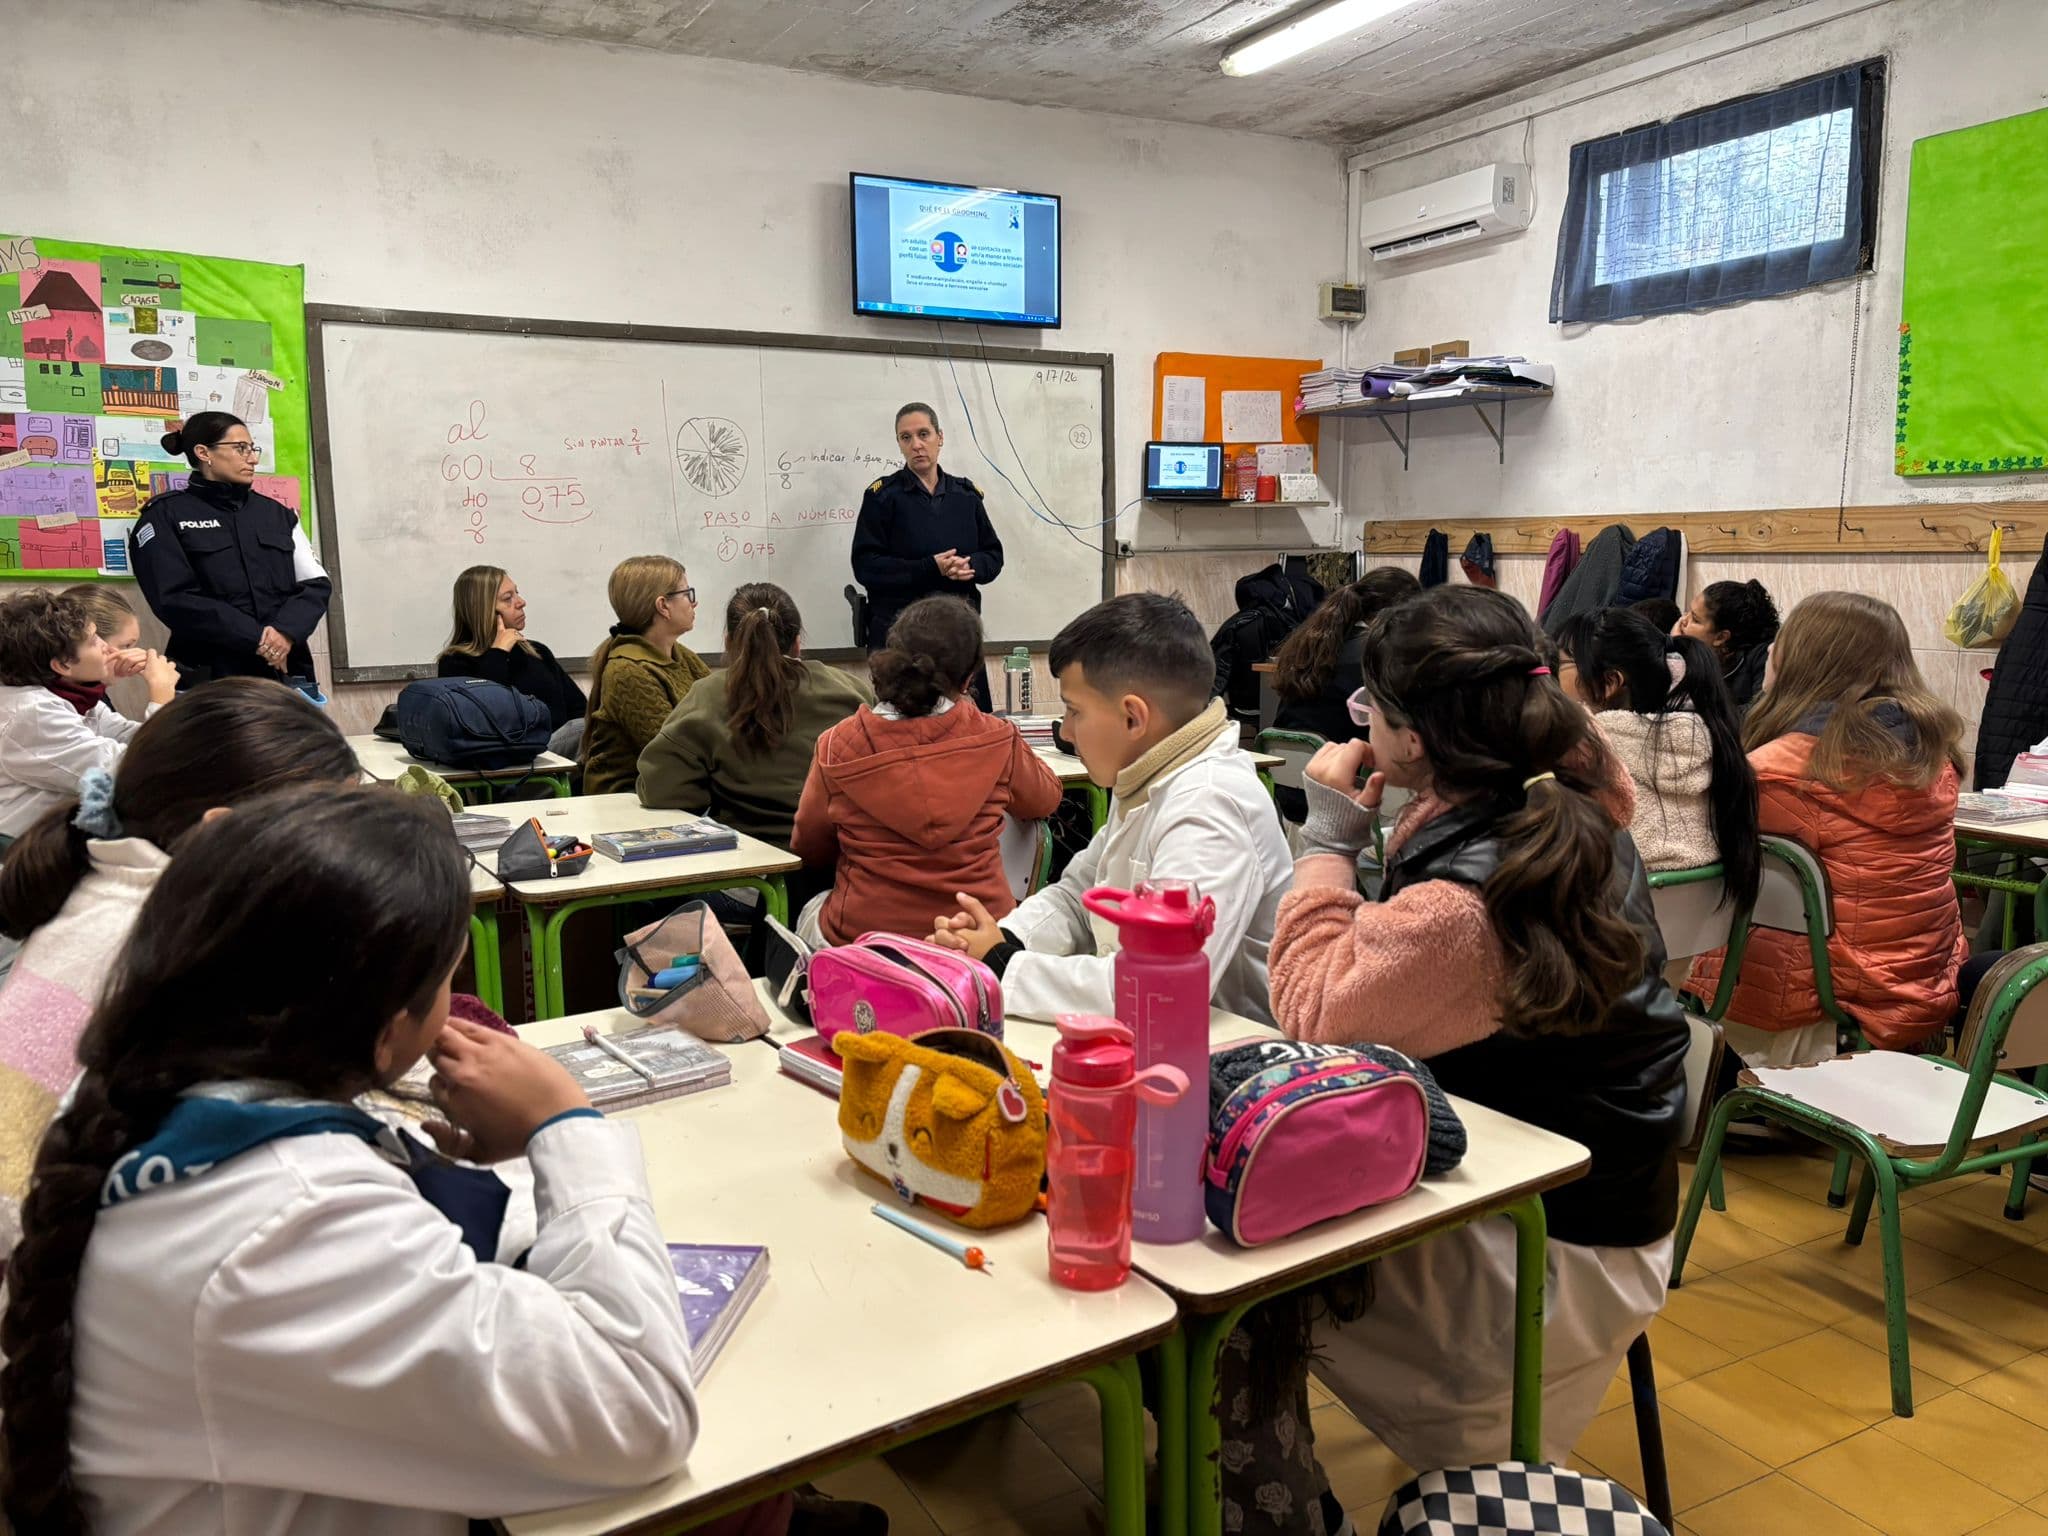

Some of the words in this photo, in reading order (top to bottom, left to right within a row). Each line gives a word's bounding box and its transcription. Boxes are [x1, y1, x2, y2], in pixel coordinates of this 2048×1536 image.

[121, 294, 158, 306] GARAGE
[1036, 369, 1078, 385] 9/7/26
[447, 400, 488, 444] al
[631, 428, 641, 442] 2
[1073, 431, 1088, 445] 22
[441, 454, 483, 482] 60
[519, 454, 536, 476] 8
[778, 451, 791, 472] 6
[781, 473, 792, 490] 8
[704, 511, 751, 528] PASO
[771, 512, 782, 524] A
